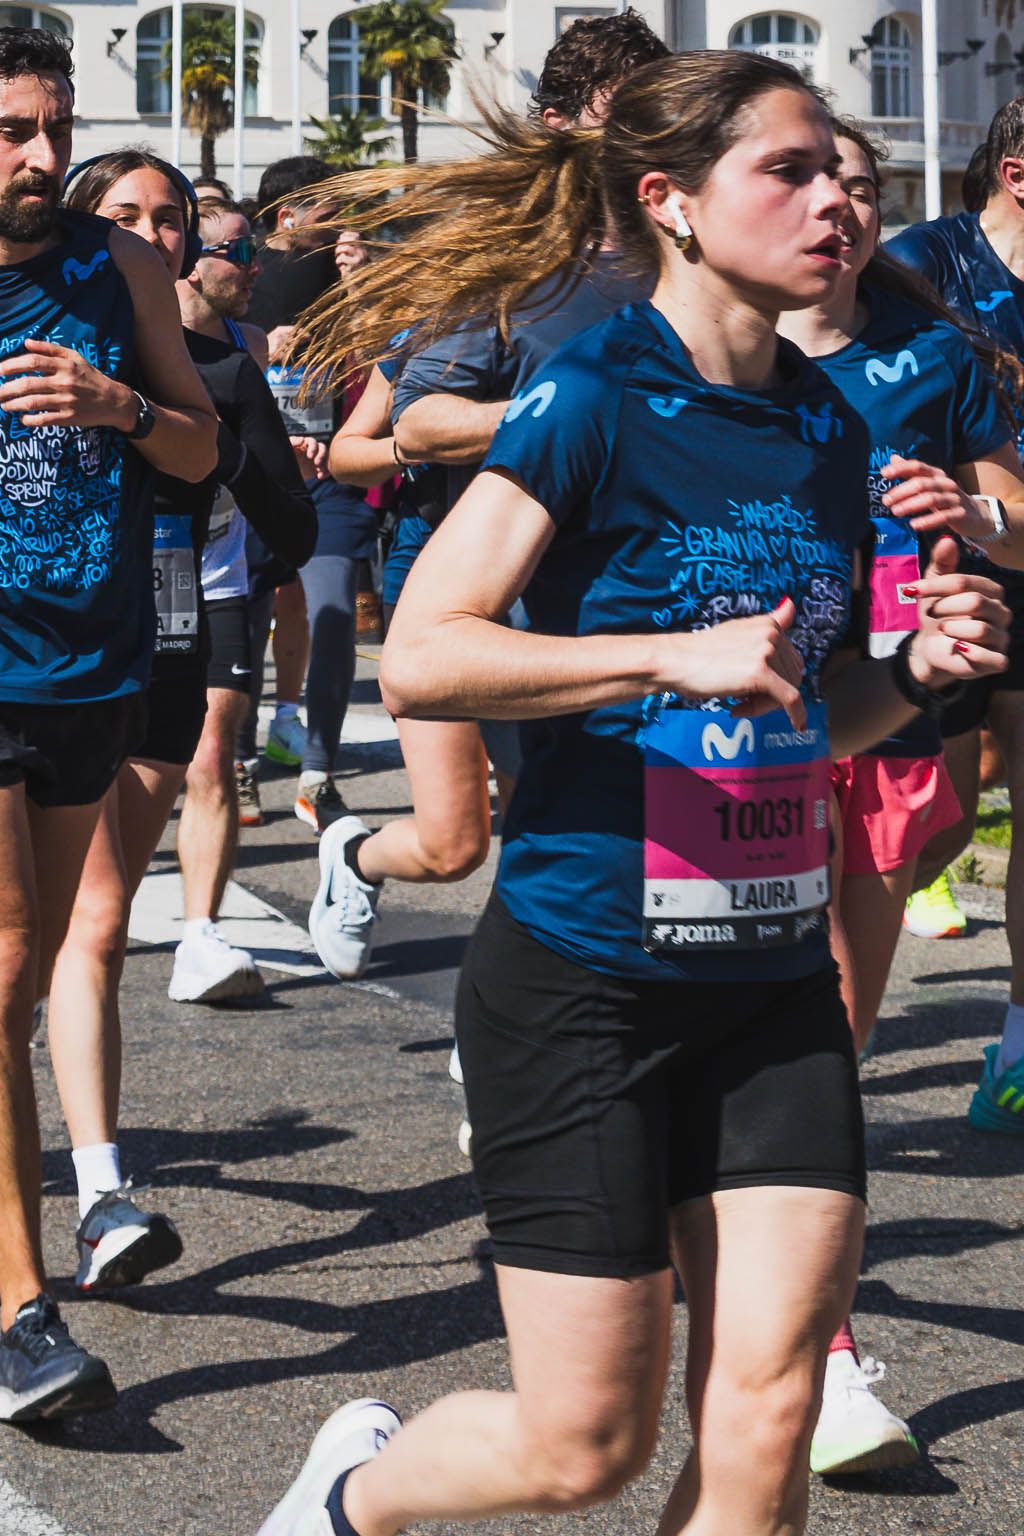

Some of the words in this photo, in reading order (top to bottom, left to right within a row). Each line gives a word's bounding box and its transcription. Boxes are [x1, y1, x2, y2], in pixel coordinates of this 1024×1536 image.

[5, 478, 56, 502] SPRINT
[714, 797, 805, 842] 10031
[729, 879, 799, 912] LAURA
